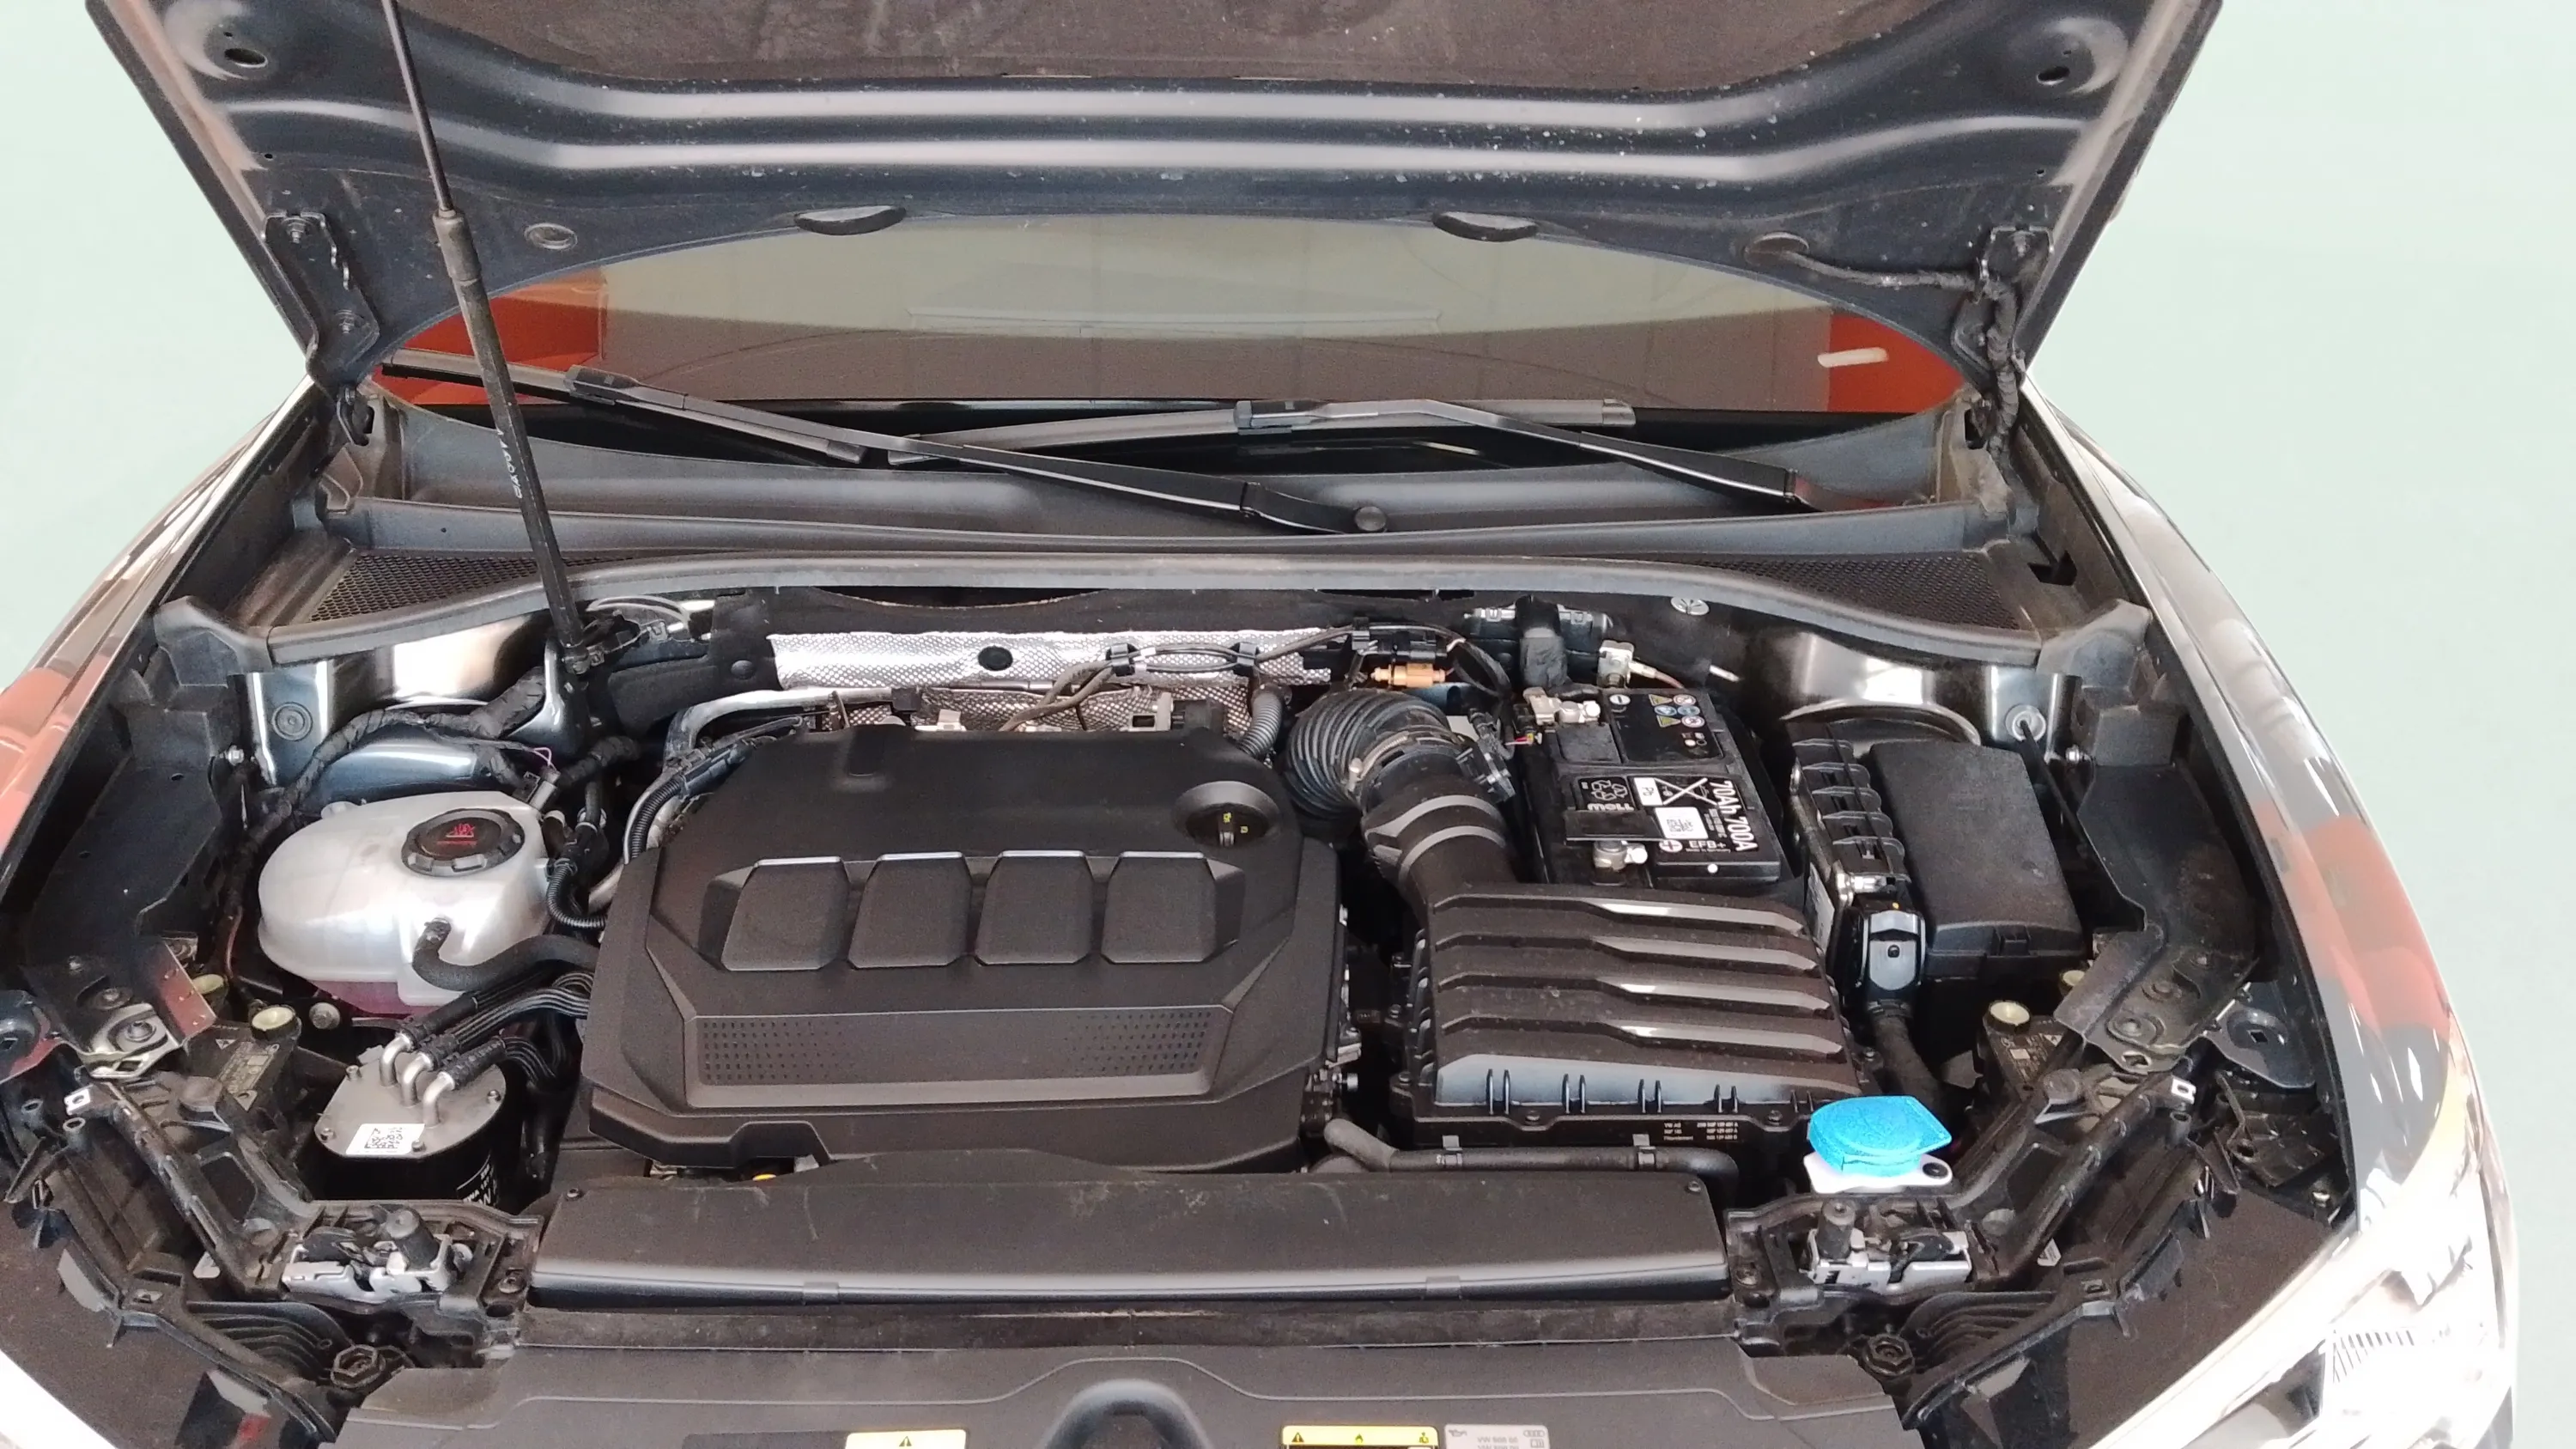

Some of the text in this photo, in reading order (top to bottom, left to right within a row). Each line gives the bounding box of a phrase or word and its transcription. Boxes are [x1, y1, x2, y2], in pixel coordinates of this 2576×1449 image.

[1710, 780, 1742, 814] 70Ah
[1688, 840, 1727, 849] EFB+
[1724, 816, 1759, 851] 700A
